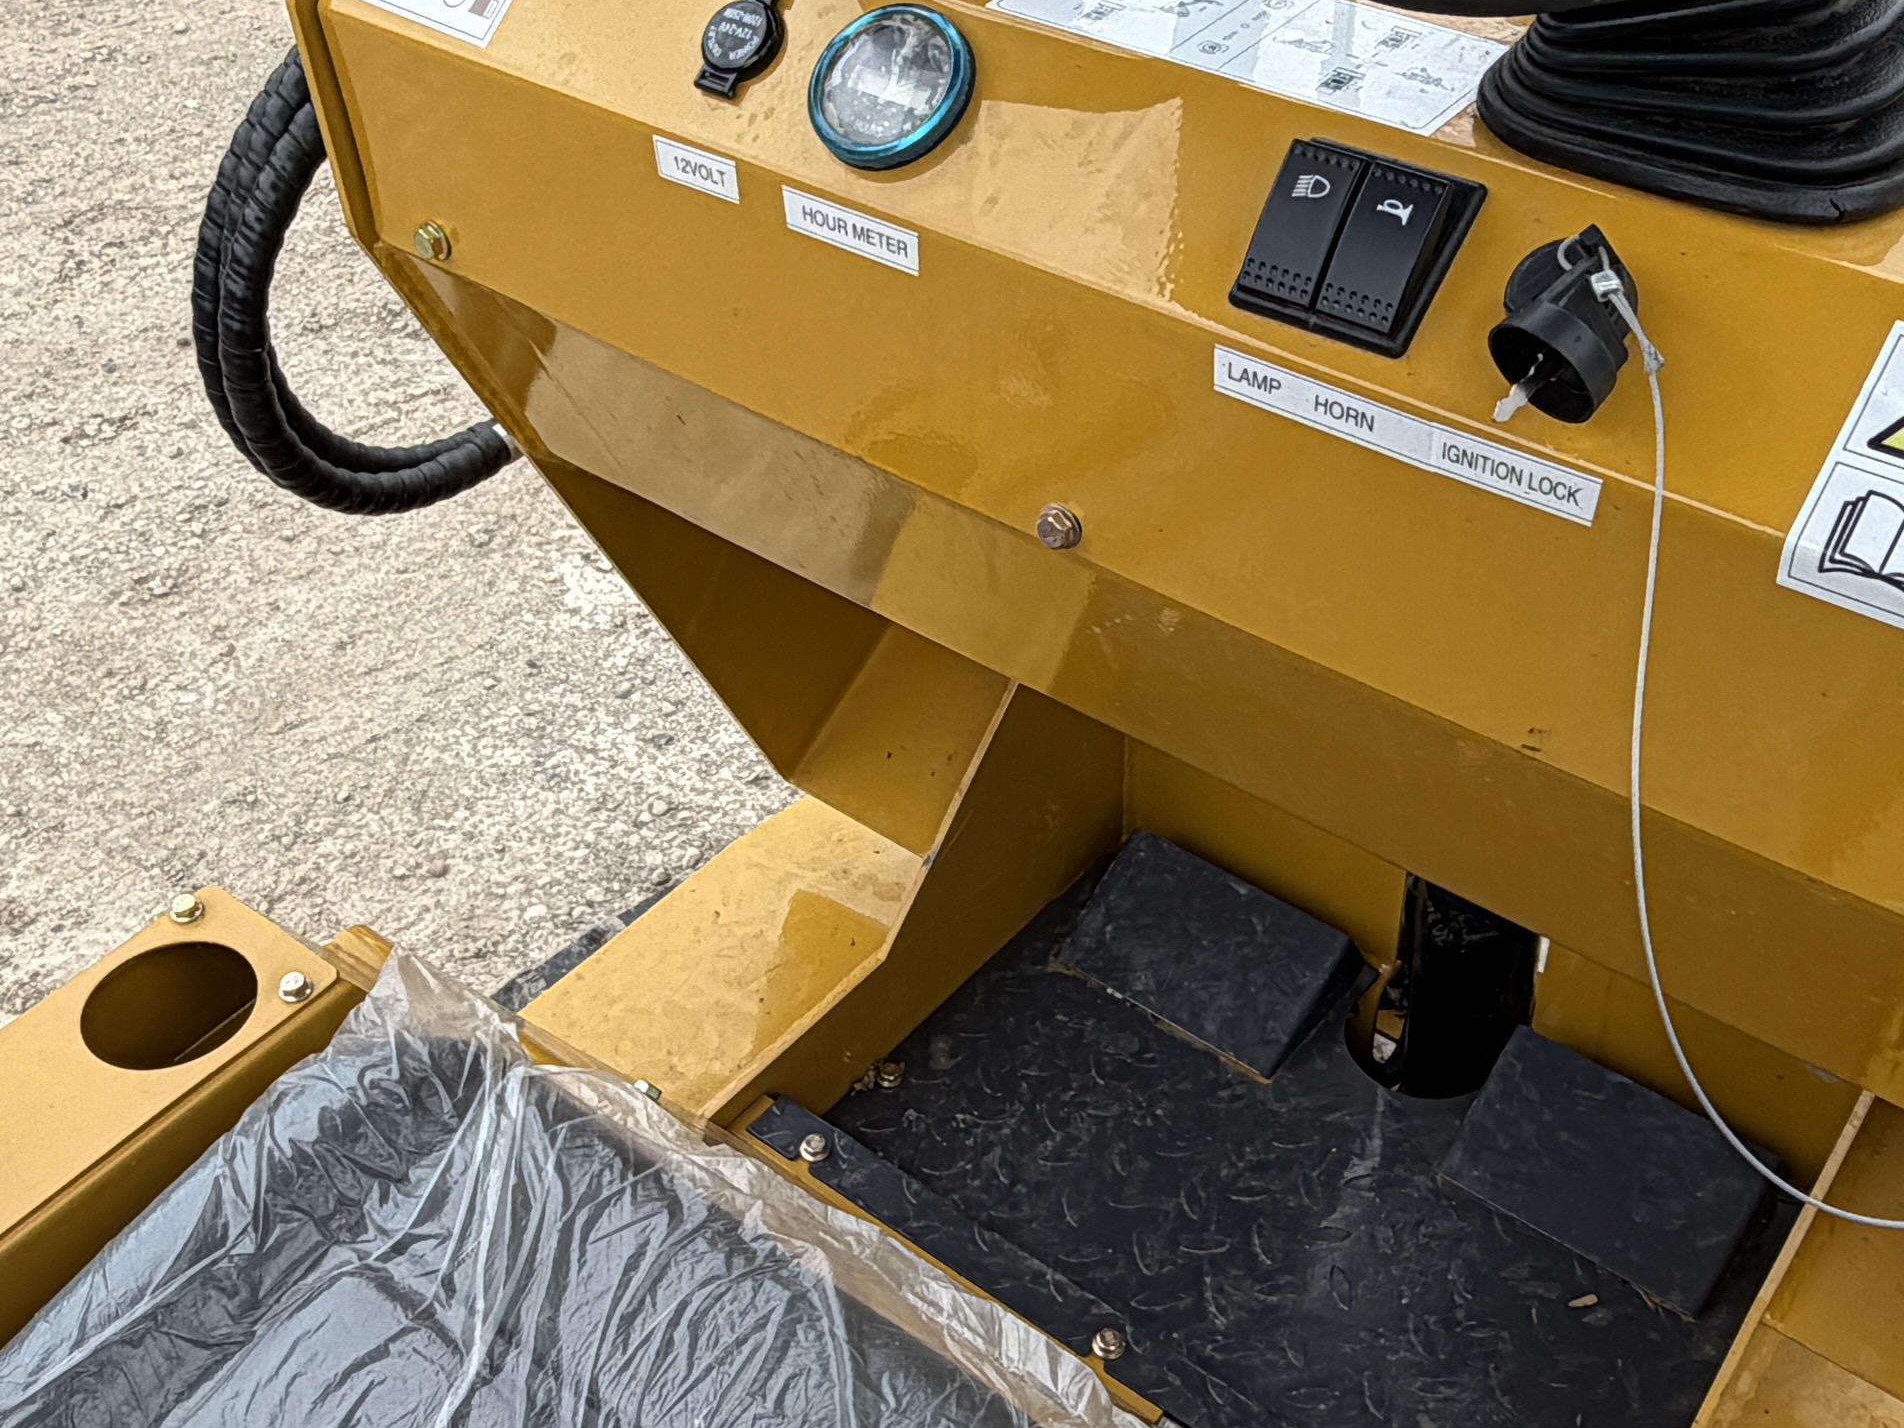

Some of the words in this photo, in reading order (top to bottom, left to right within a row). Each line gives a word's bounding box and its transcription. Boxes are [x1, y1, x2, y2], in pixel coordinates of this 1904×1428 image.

[673, 155, 727, 189] 12VOLT
[801, 204, 848, 237] HOUR
[851, 222, 909, 258] METER
[1227, 361, 1283, 395] LAMP
[1313, 394, 1376, 433] HORN
[1441, 442, 1524, 488] IGNITION
[1527, 472, 1582, 507] LOCK
